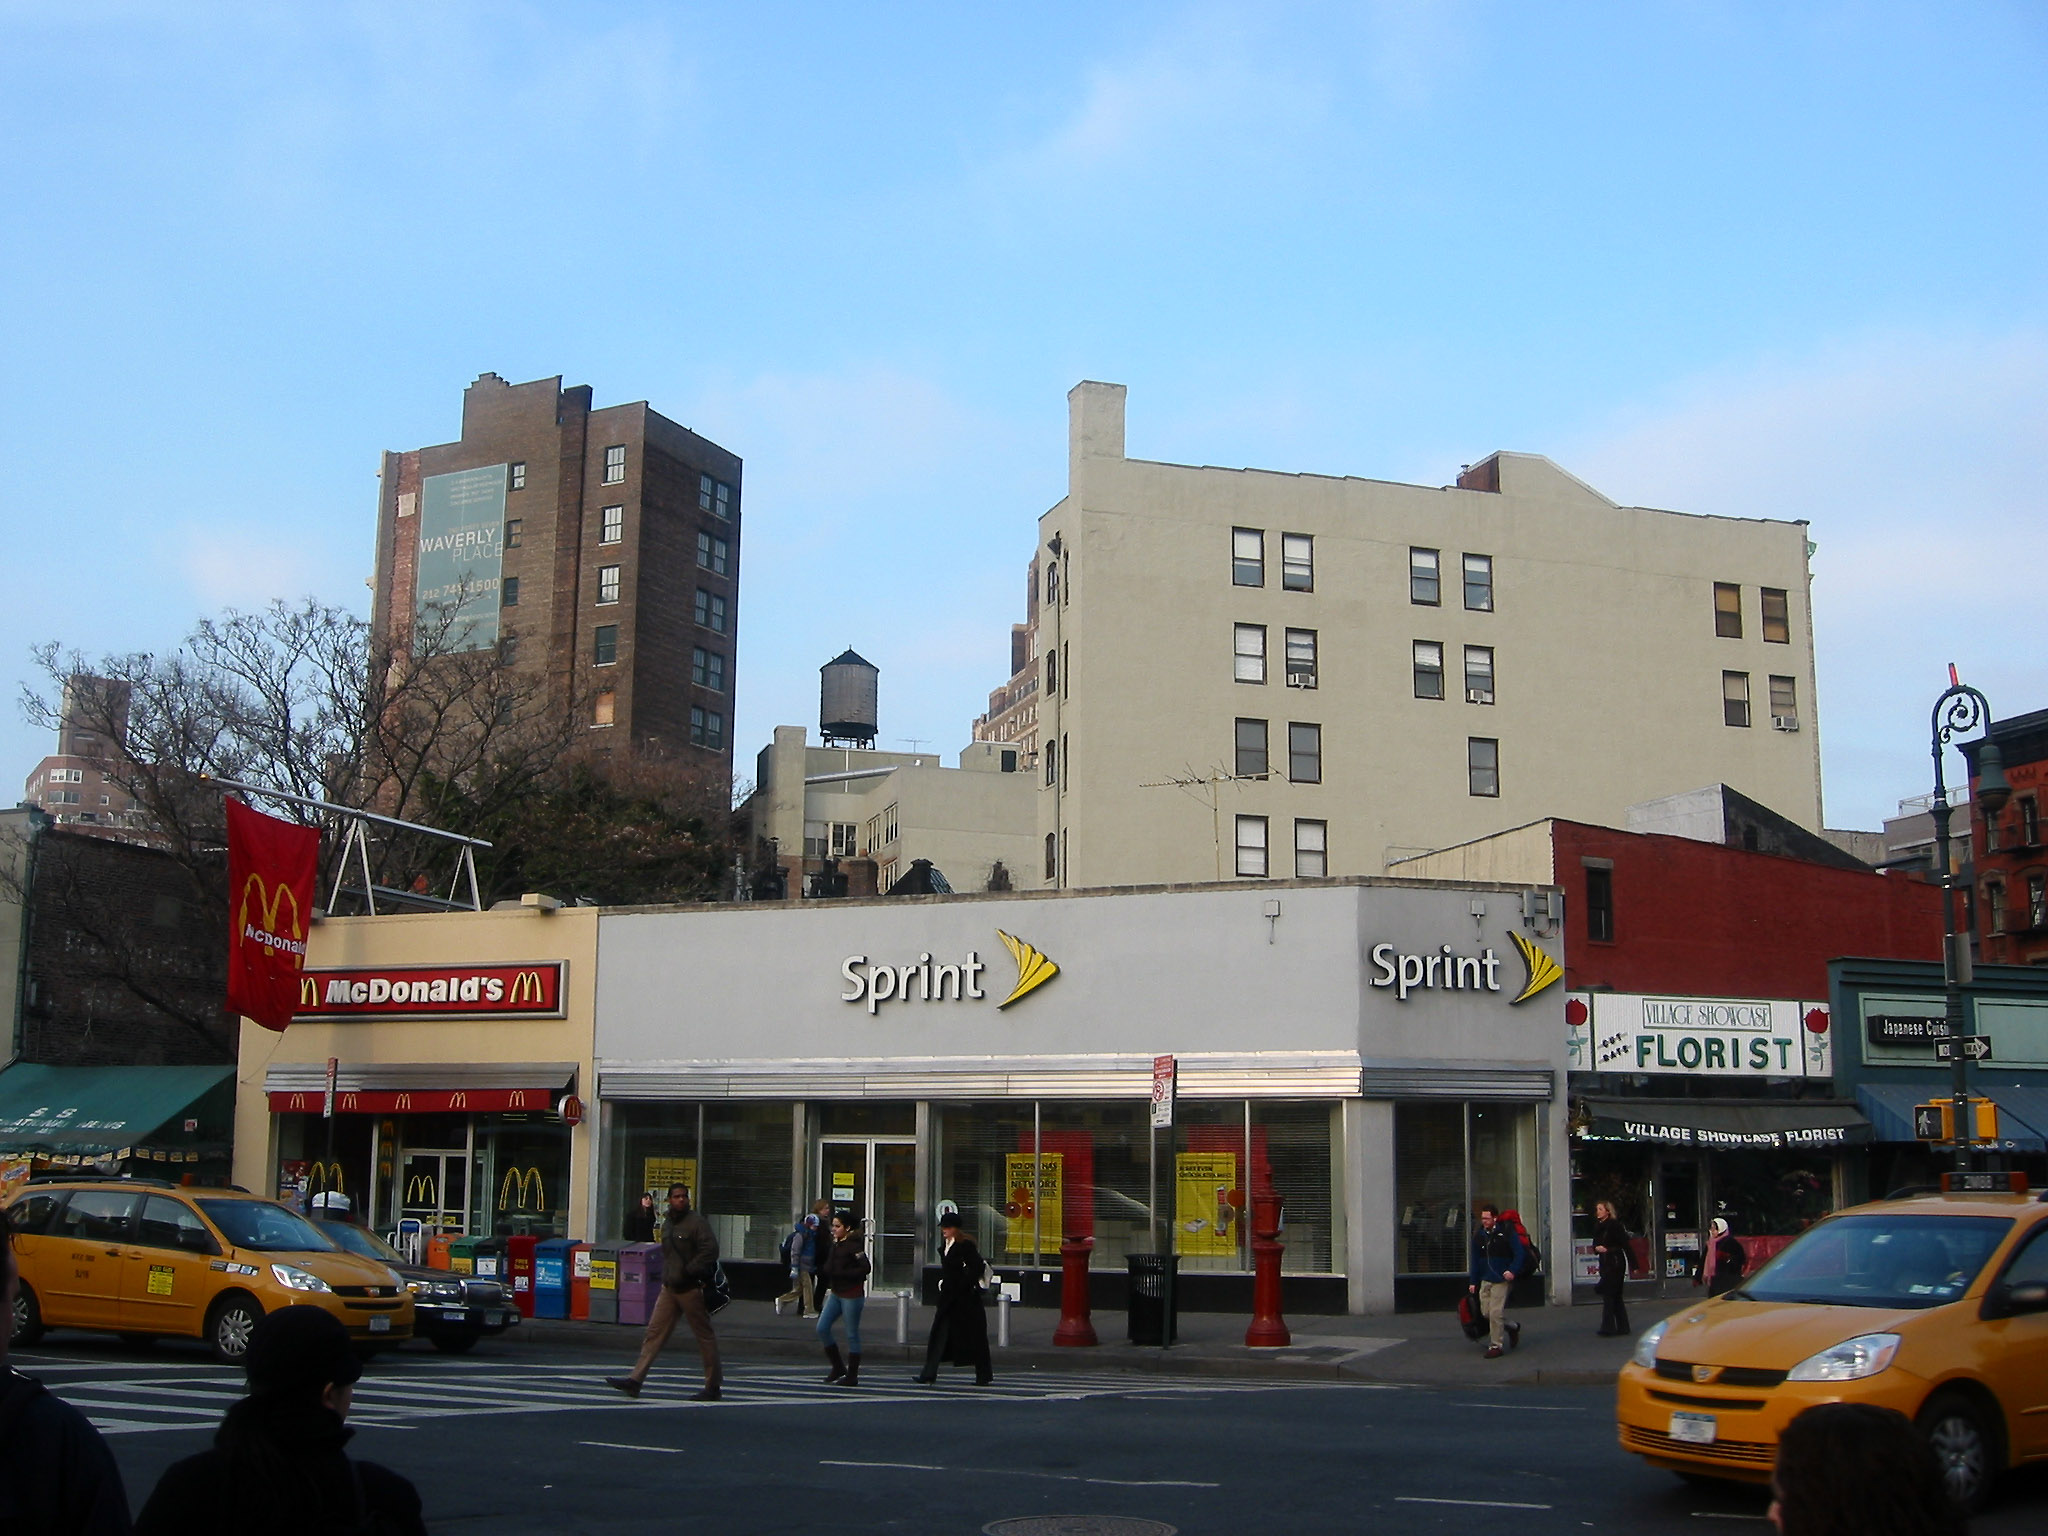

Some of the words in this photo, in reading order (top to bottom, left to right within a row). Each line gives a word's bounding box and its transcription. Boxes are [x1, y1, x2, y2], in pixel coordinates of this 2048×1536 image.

[419, 527, 495, 553] WAVERLY
[452, 541, 503, 565] PLACE
[422, 588, 440, 600] 212
[841, 951, 985, 1015] Sprint
[1369, 942, 1501, 1001] Sprint
[325, 976, 505, 1004] McDonald's
[1645, 1003, 1693, 1025] VILLAGE
[1697, 1005, 1770, 1028] SHOWCASE
[1602, 1032, 1622, 1048] CUT
[1883, 1019, 1924, 1038] Japanese
[1603, 1045, 1629, 1062] RATE
[1635, 1033, 1793, 1070] FLORIST
[1624, 1121, 1692, 1141] VILLAGE
[1696, 1129, 1781, 1145] SHOWCASE
[1785, 1128, 1845, 1144] FLORIST
[1024, 1162, 1037, 1170] ON
